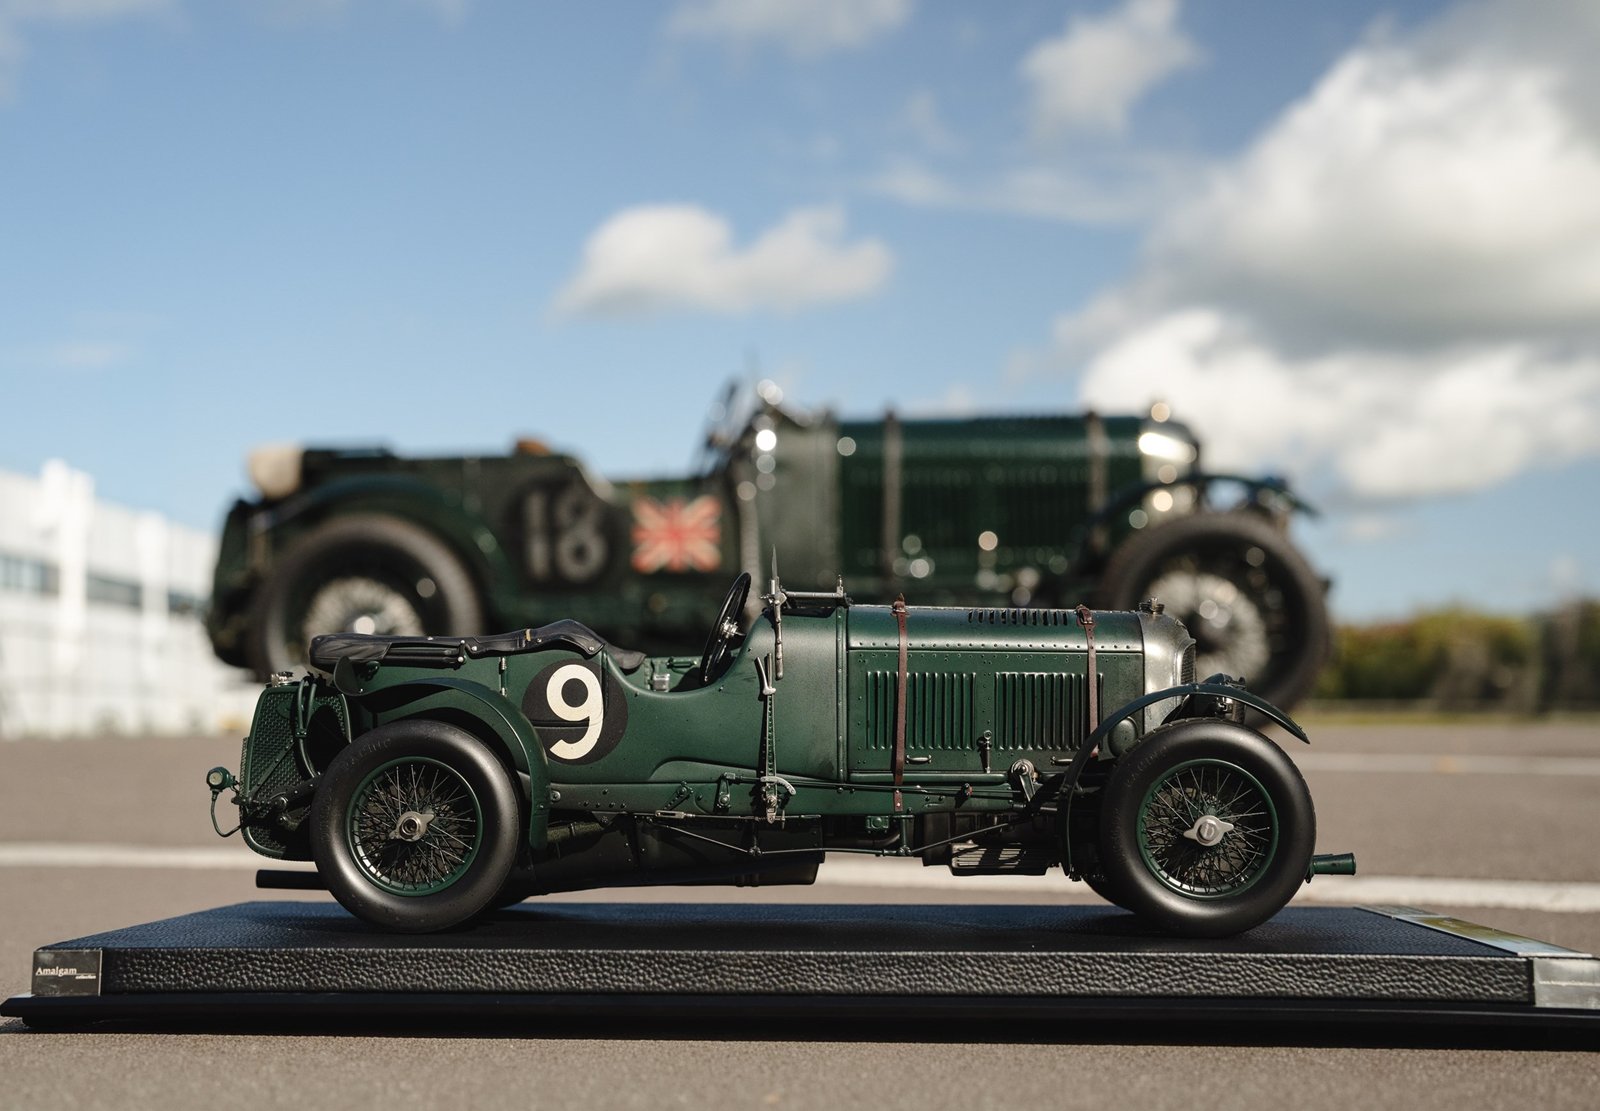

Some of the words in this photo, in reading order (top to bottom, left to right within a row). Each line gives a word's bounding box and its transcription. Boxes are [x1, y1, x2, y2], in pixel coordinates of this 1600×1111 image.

[526, 489, 607, 582] 18
[546, 664, 604, 760] 9
[35, 966, 77, 977] Amalgam
